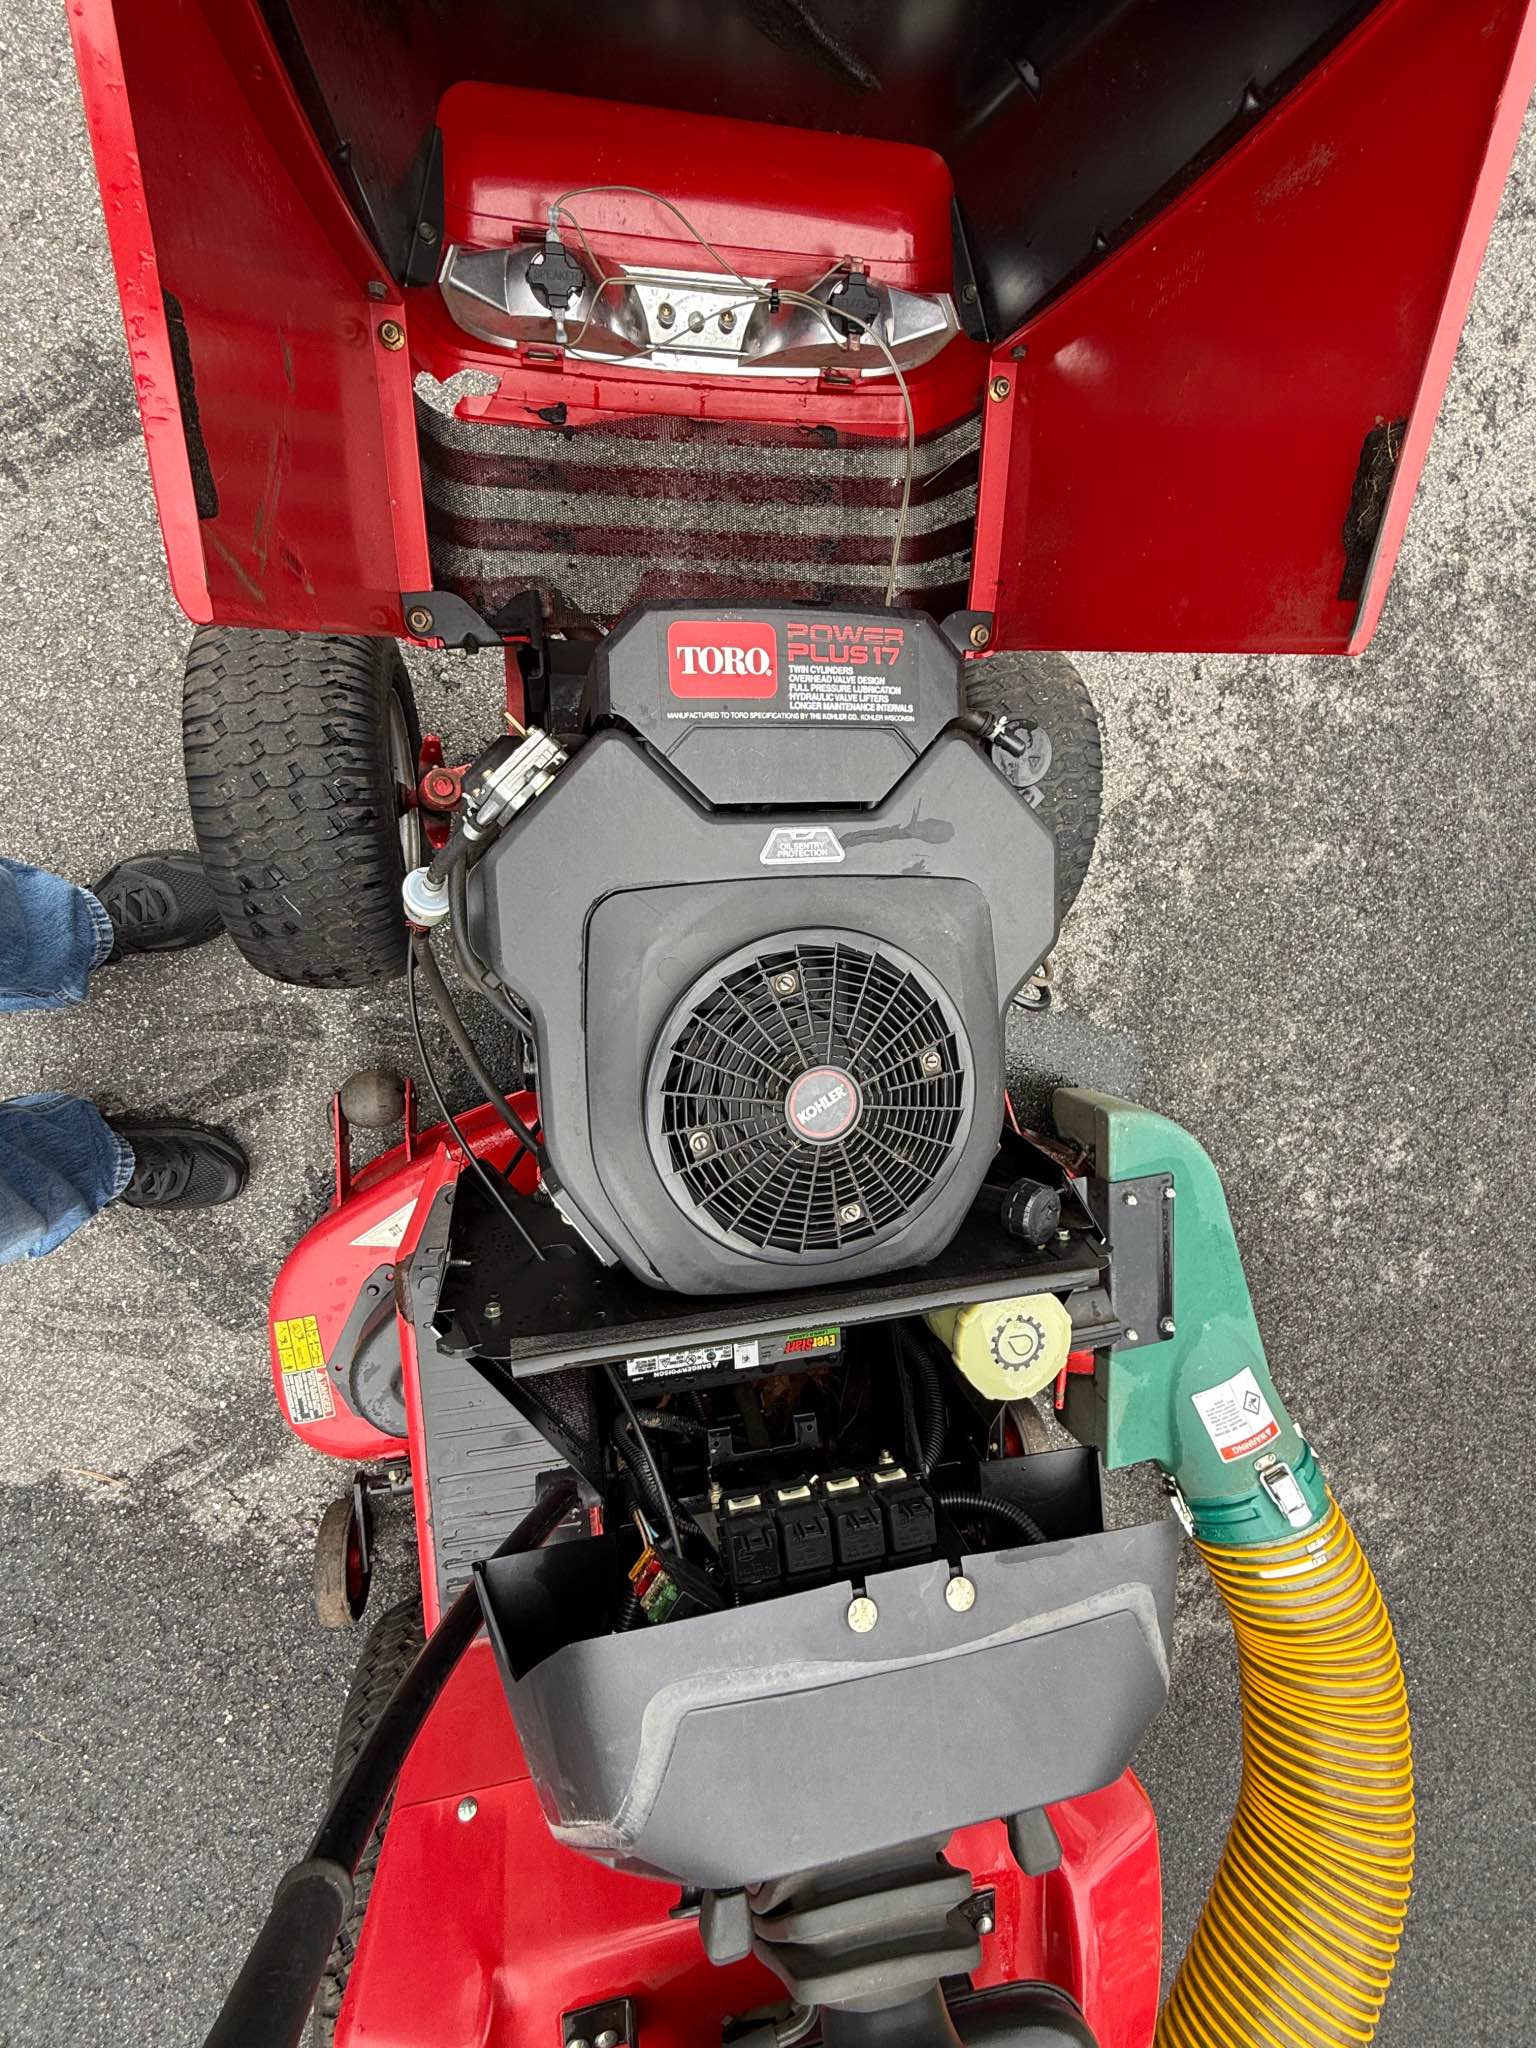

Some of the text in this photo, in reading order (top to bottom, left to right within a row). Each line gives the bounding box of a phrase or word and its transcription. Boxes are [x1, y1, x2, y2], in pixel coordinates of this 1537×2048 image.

[787, 623, 904, 646] POWER
[787, 642, 900, 665] PLUS 17
[788, 664, 854, 675] TWIN CYLINDERS
[788, 674, 885, 685] OVERHEAD VALVE DESIGN
[789, 683, 902, 695] FULL PRESSURE LUBRICATION
[789, 692, 889, 703] HYDRAULIC VALVE LIFTERS
[790, 701, 914, 713] LONGER MAINTENANCE INTERVALS
[667, 711, 720, 719] MANUFACTURED
[720, 711, 730, 719] TO
[730, 711, 749, 719] TORO
[749, 712, 800, 720] SPECIFICATIONS
[800, 712, 809, 720] BY
[809, 712, 822, 720] THE
[793, 842, 825, 850] SENTRY
[777, 849, 829, 858] PROTECTION
[796, 1086, 848, 1125] KOHLER
[784, 1334, 836, 1353] EverStart
[319, 1379, 334, 1412] DANGER
[1231, 1430, 1268, 1455] WARNING
